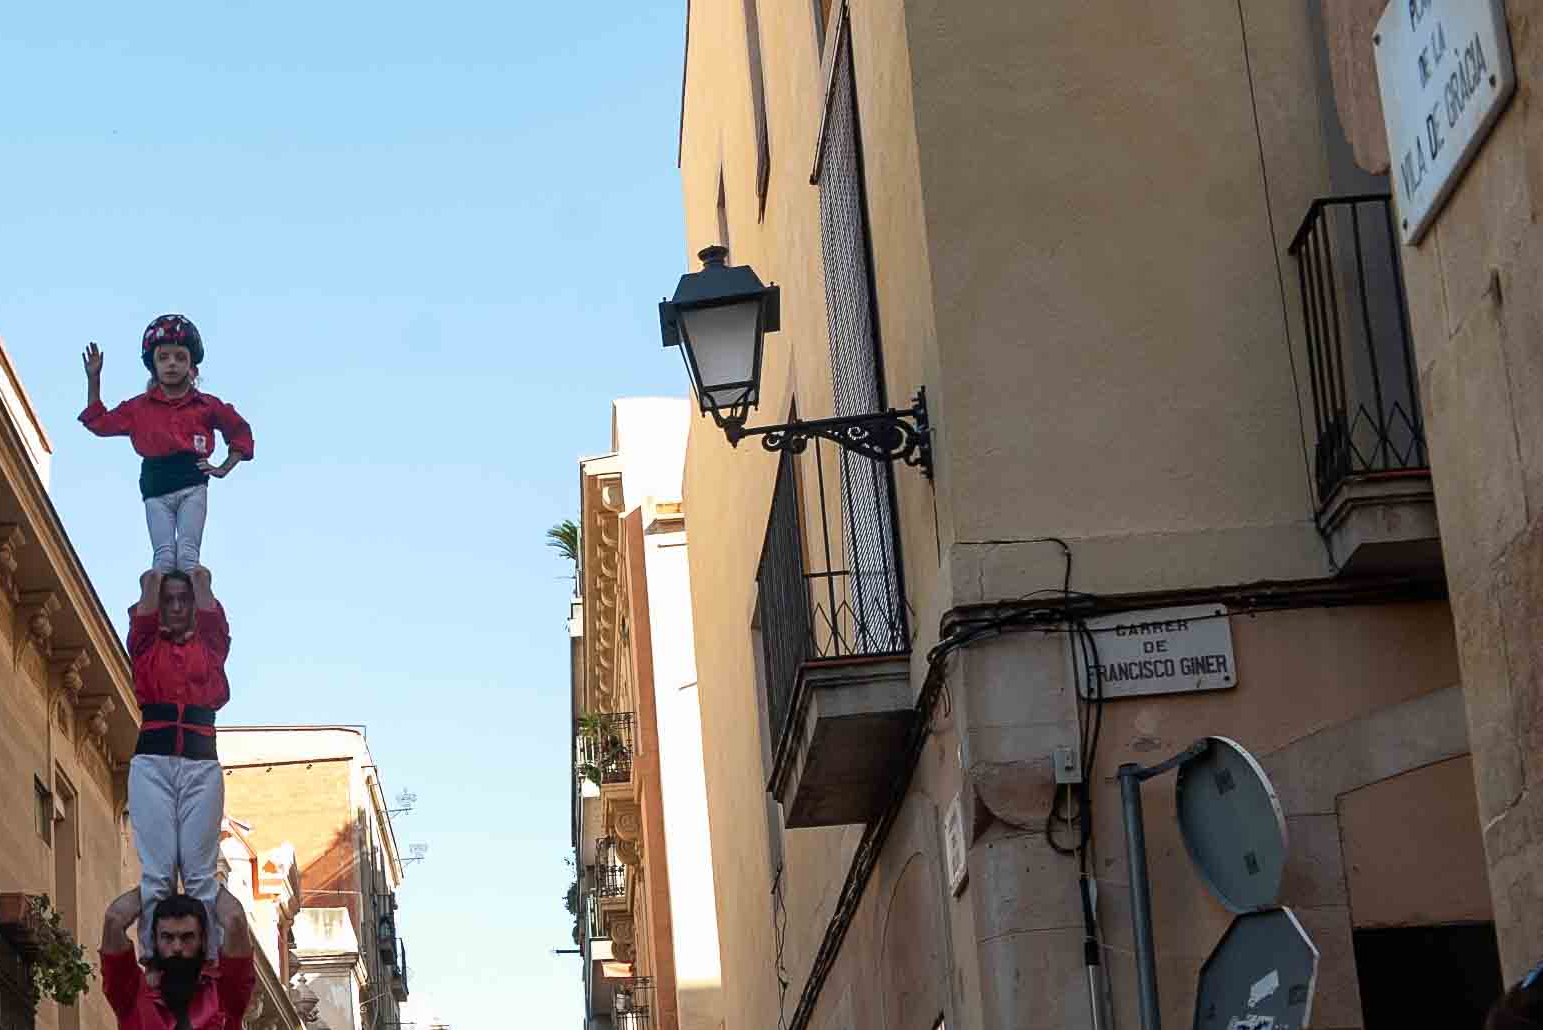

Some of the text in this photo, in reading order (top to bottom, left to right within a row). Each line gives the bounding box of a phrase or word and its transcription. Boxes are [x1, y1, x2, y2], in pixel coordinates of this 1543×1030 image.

[1400, 136, 1429, 201] VILA
[1426, 102, 1446, 161] DE
[1114, 619, 1190, 637] CARRER
[1143, 639, 1168, 654] DE
[1180, 654, 1229, 676] GINER
